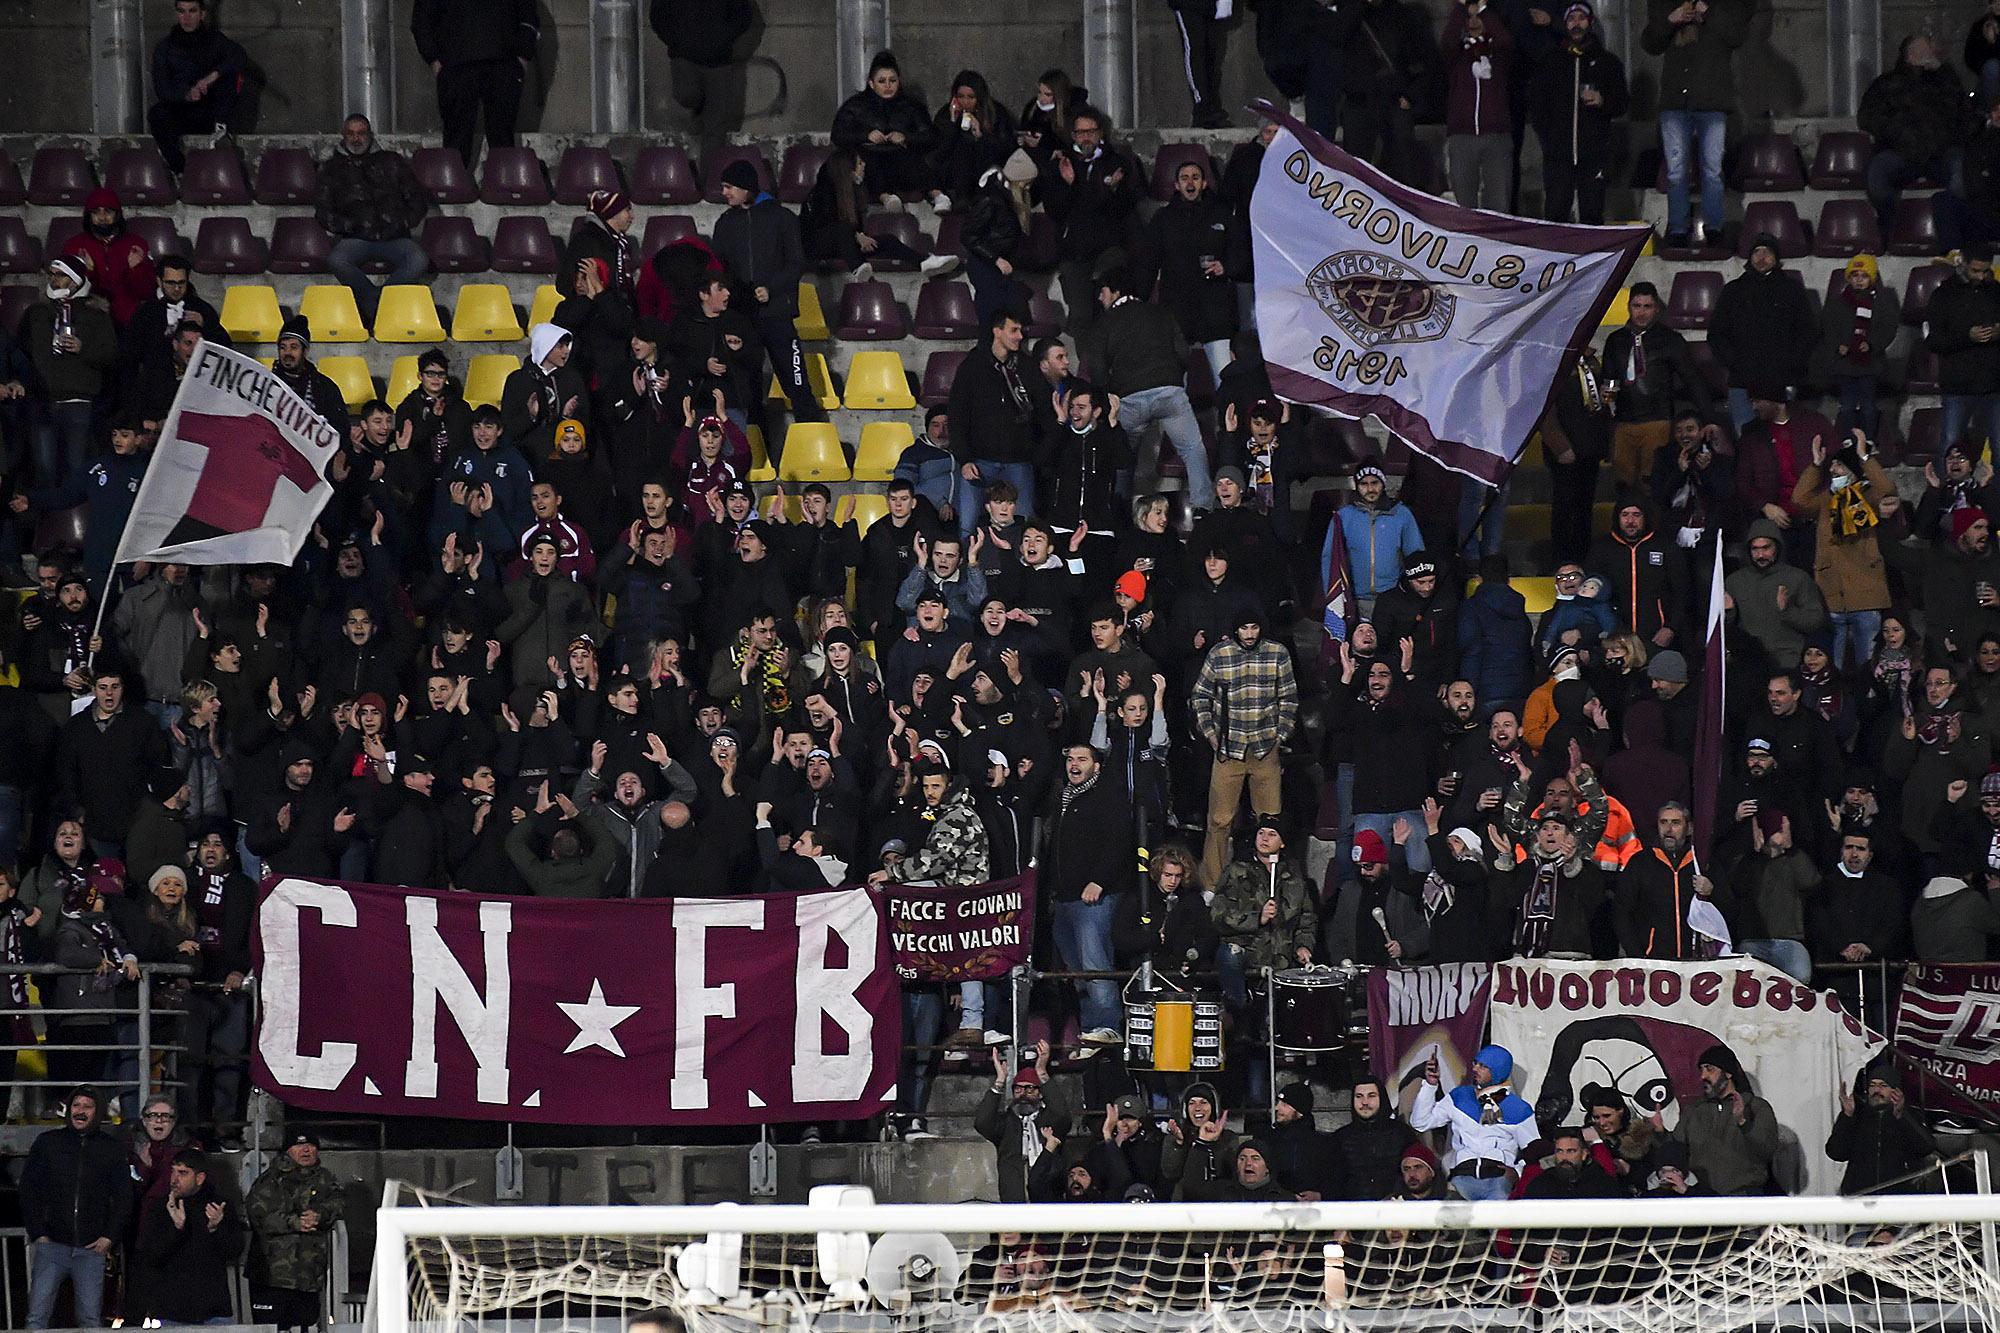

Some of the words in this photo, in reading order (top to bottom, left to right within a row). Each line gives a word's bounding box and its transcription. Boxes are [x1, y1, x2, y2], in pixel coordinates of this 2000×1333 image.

[890, 898, 947, 921] FACCE
[956, 891, 1023, 918] GIOVANI
[891, 931, 955, 953] VECCHI
[958, 924, 1021, 950] VALORI
